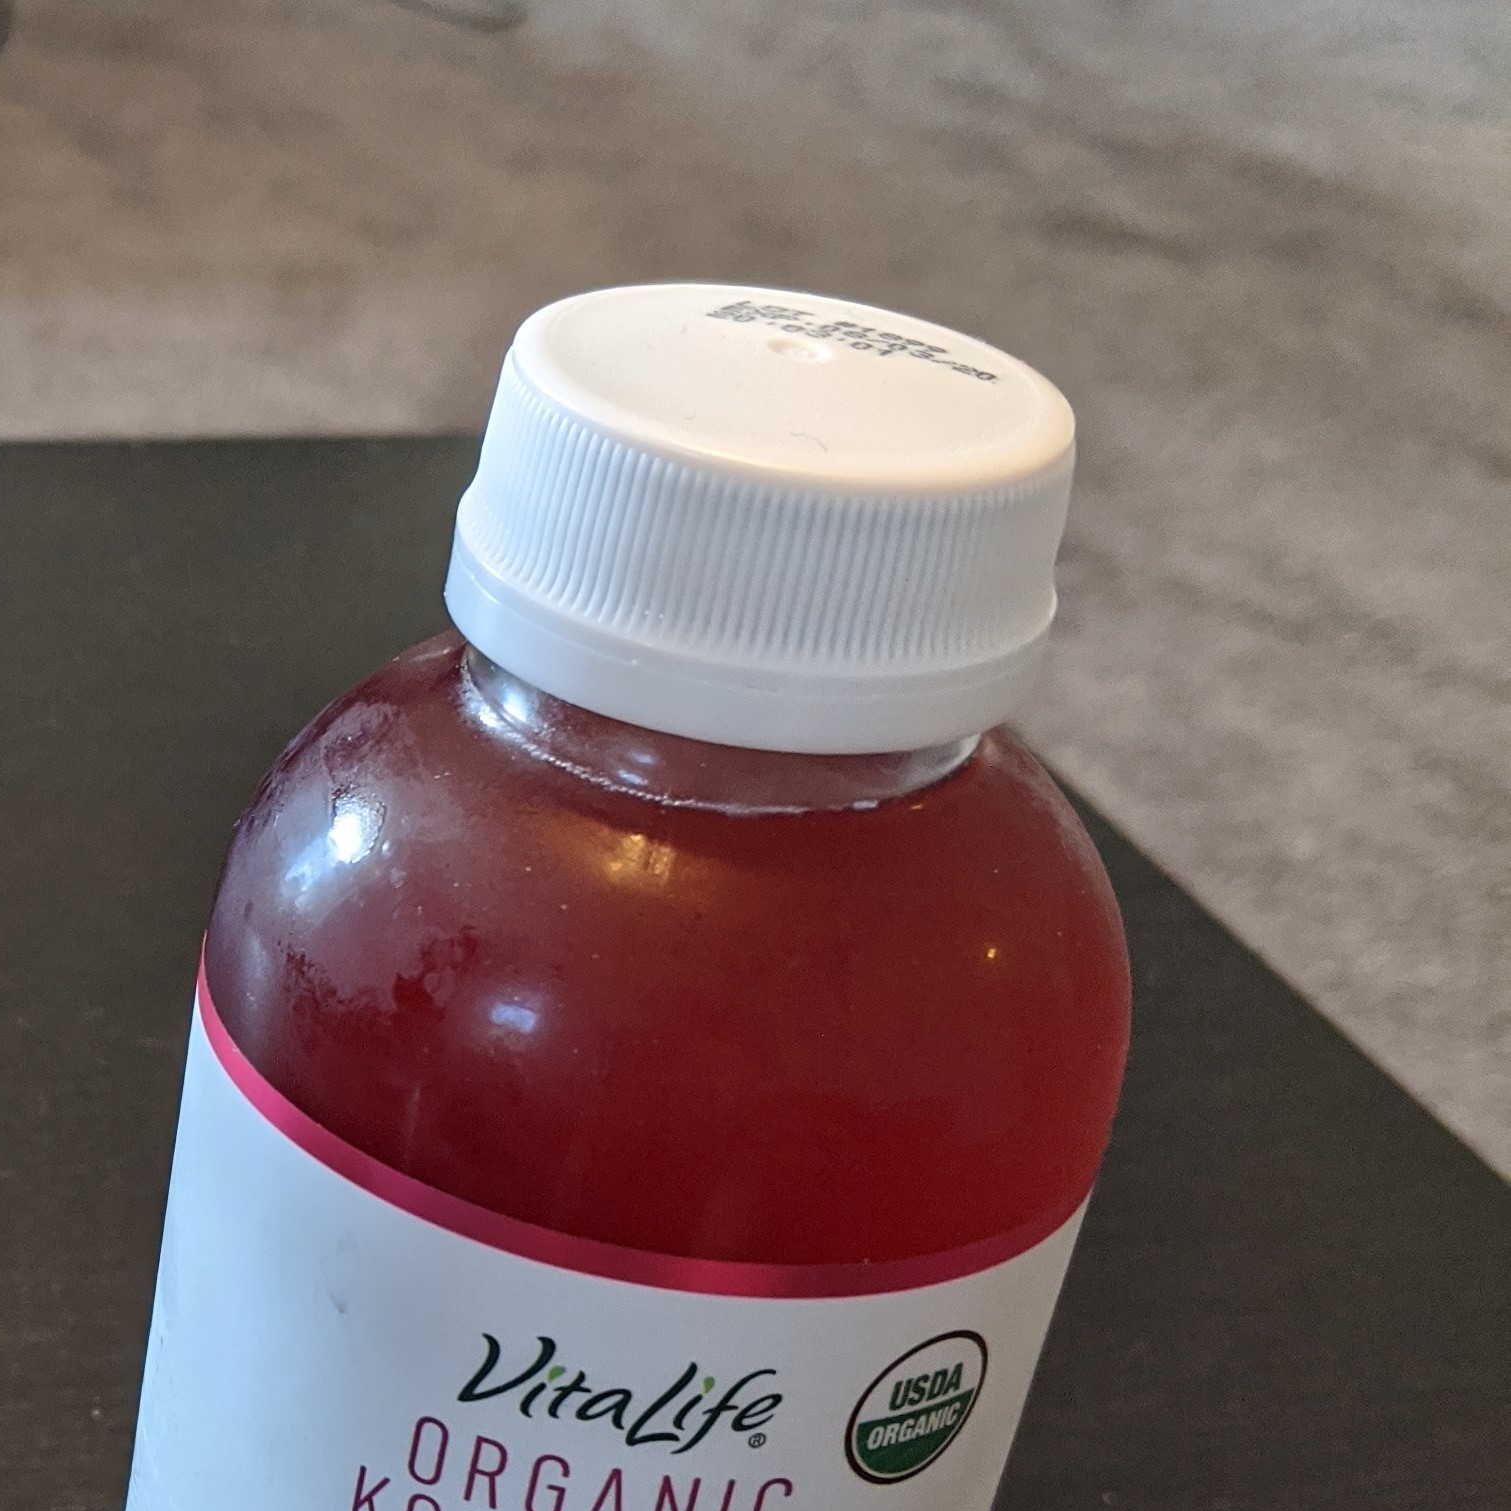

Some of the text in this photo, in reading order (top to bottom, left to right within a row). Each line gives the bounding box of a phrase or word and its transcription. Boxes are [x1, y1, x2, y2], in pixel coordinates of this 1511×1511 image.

[456, 1333, 783, 1454] VitaLife
[889, 1361, 964, 1411] USDA
[865, 1401, 961, 1450] ORGANIC
